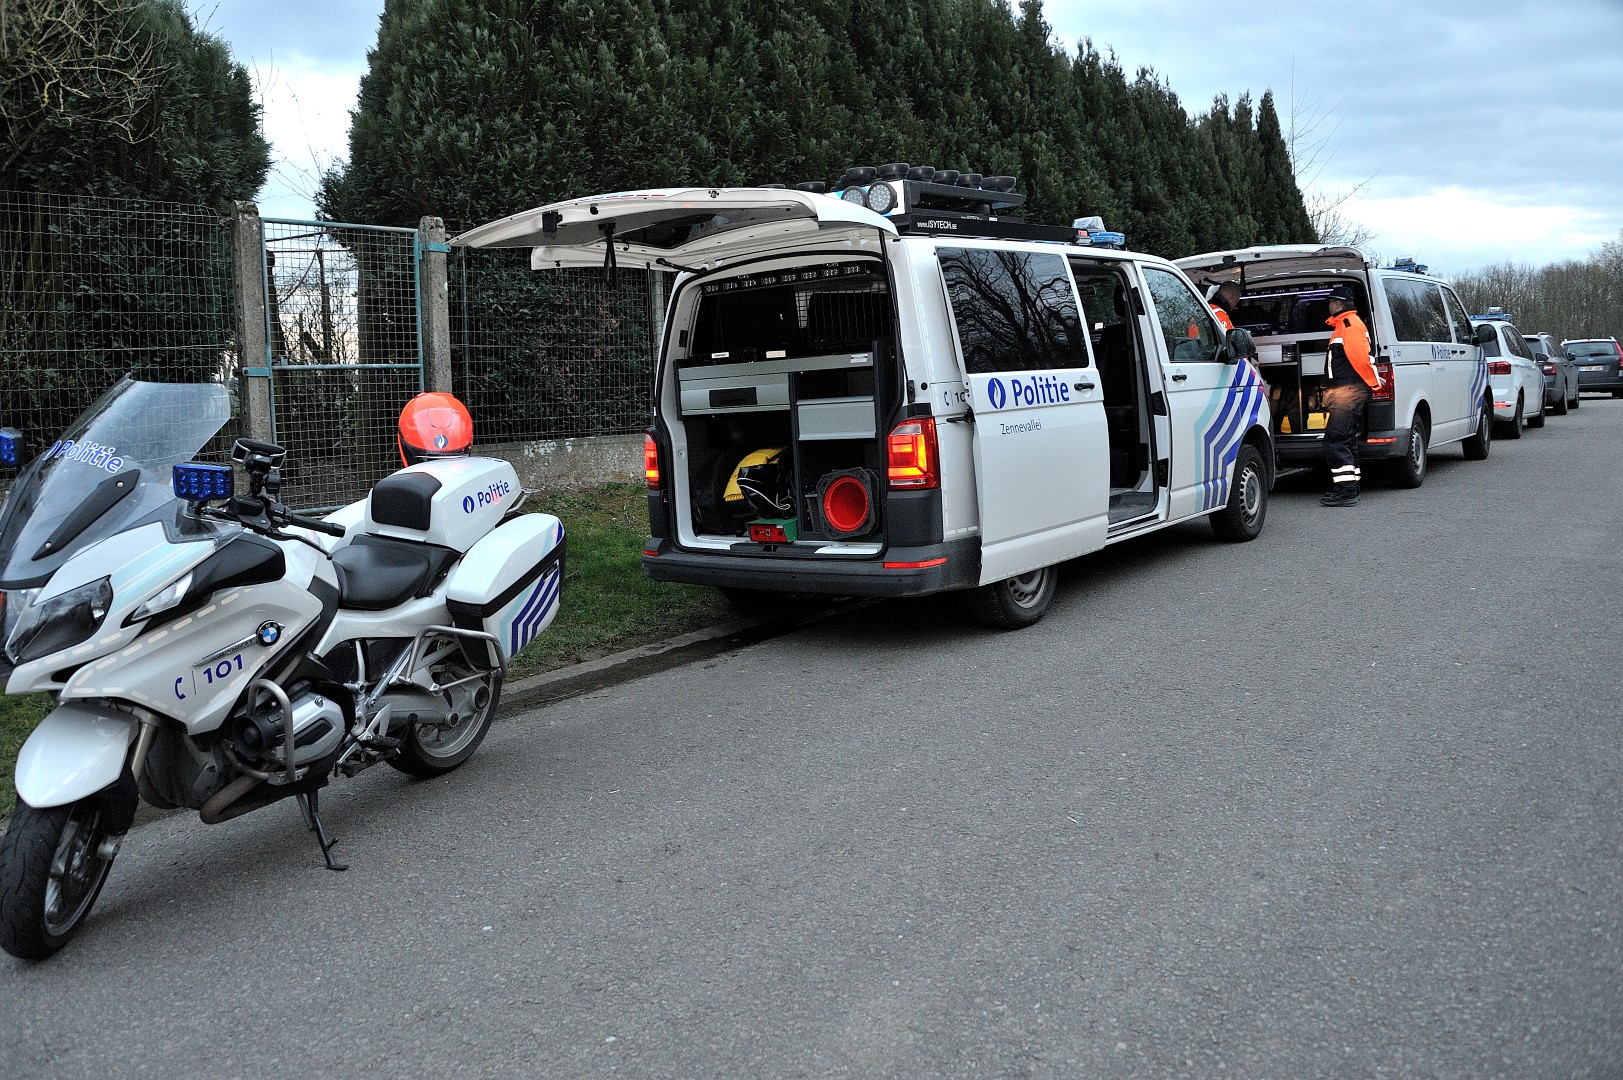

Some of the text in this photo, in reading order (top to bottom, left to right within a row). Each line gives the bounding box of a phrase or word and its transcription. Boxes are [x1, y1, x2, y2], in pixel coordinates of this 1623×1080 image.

[1011, 375, 1070, 406] Politie
[1000, 419, 1042, 435] Zennevallei
[54, 440, 124, 473] Politie
[477, 480, 510, 507] Politie
[203, 653, 243, 684] 101
